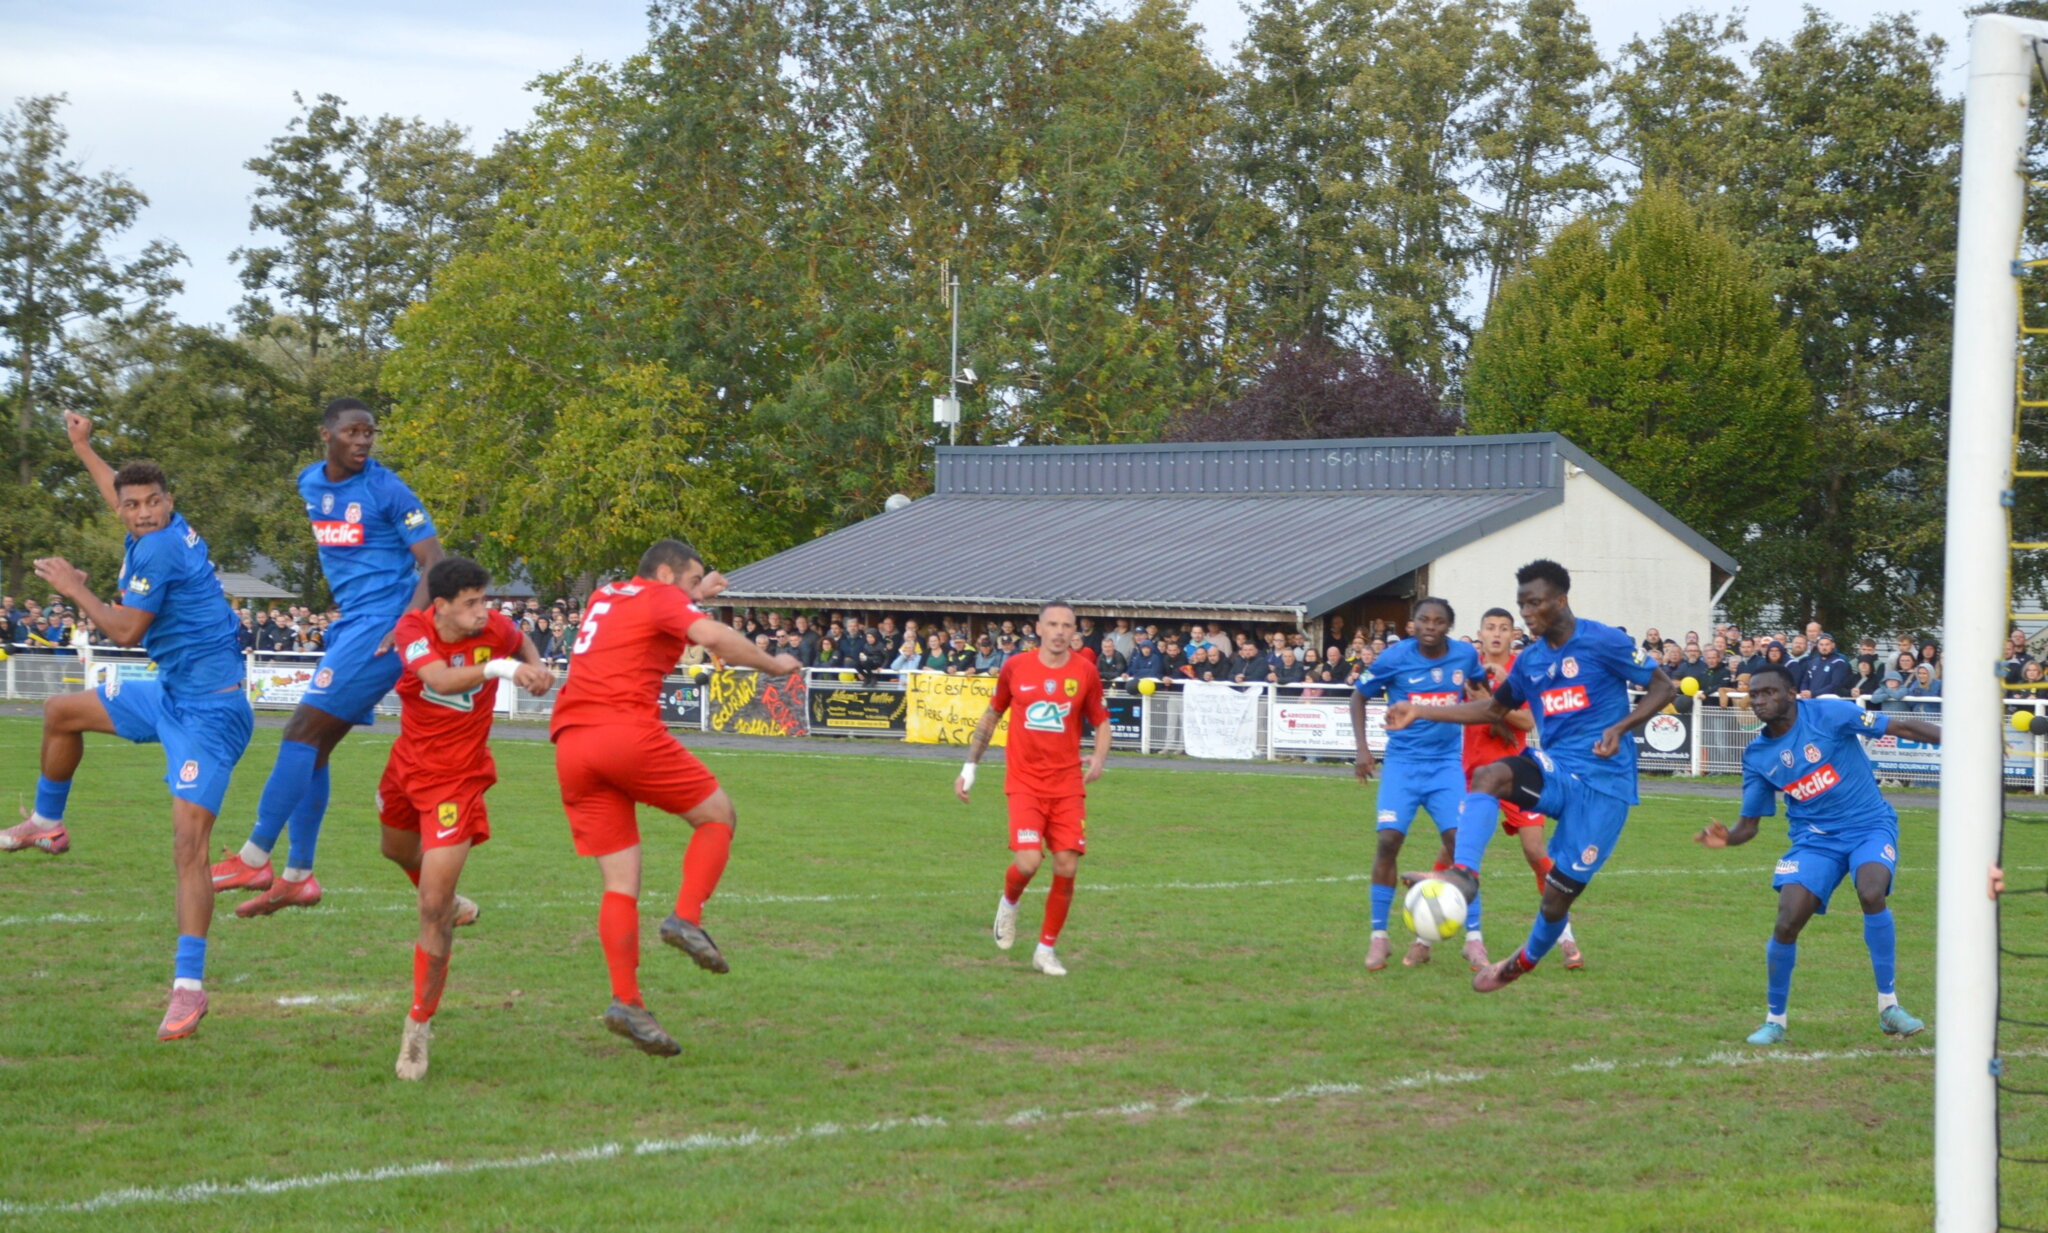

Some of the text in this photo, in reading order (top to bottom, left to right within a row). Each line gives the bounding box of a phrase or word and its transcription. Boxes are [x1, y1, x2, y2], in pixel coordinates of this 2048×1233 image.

[573, 601, 612, 655] 5
[709, 670, 736, 704] AS
[712, 672, 759, 730] GOURNAY
[911, 672, 932, 694] Ici
[971, 679, 994, 698] Gou
